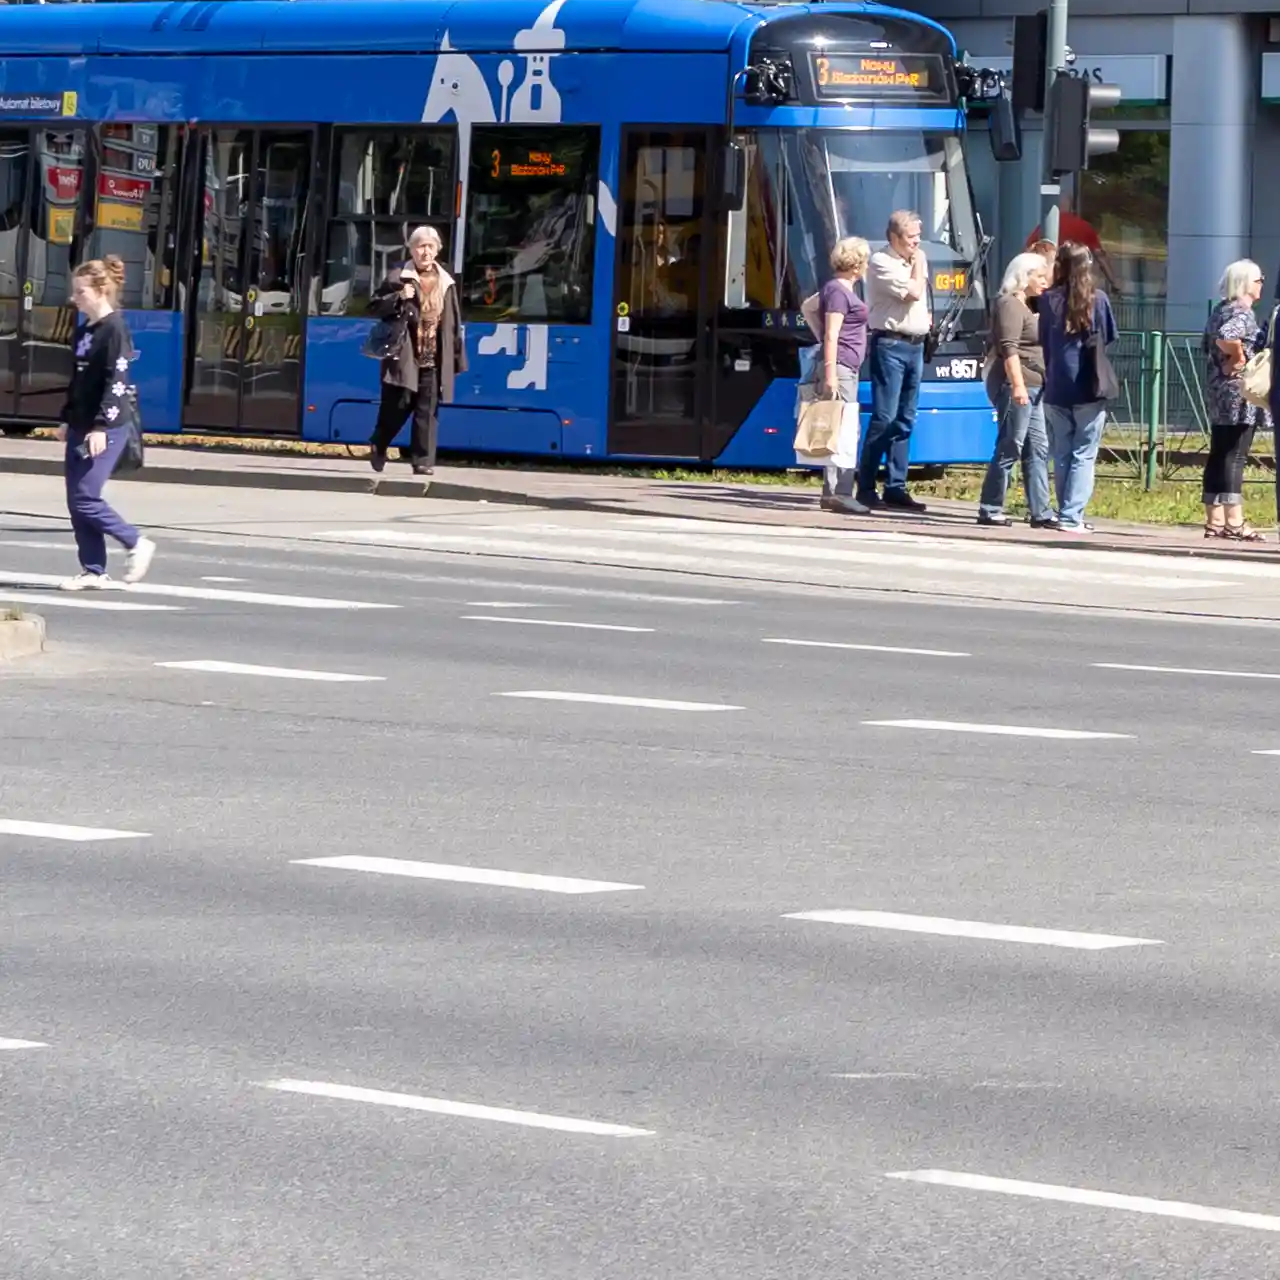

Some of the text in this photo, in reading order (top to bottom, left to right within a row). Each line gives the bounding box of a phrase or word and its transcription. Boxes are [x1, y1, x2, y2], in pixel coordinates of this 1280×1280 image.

[816, 58, 829, 86] 3
[491, 149, 501, 178] 3
[951, 359, 977, 378] 867
